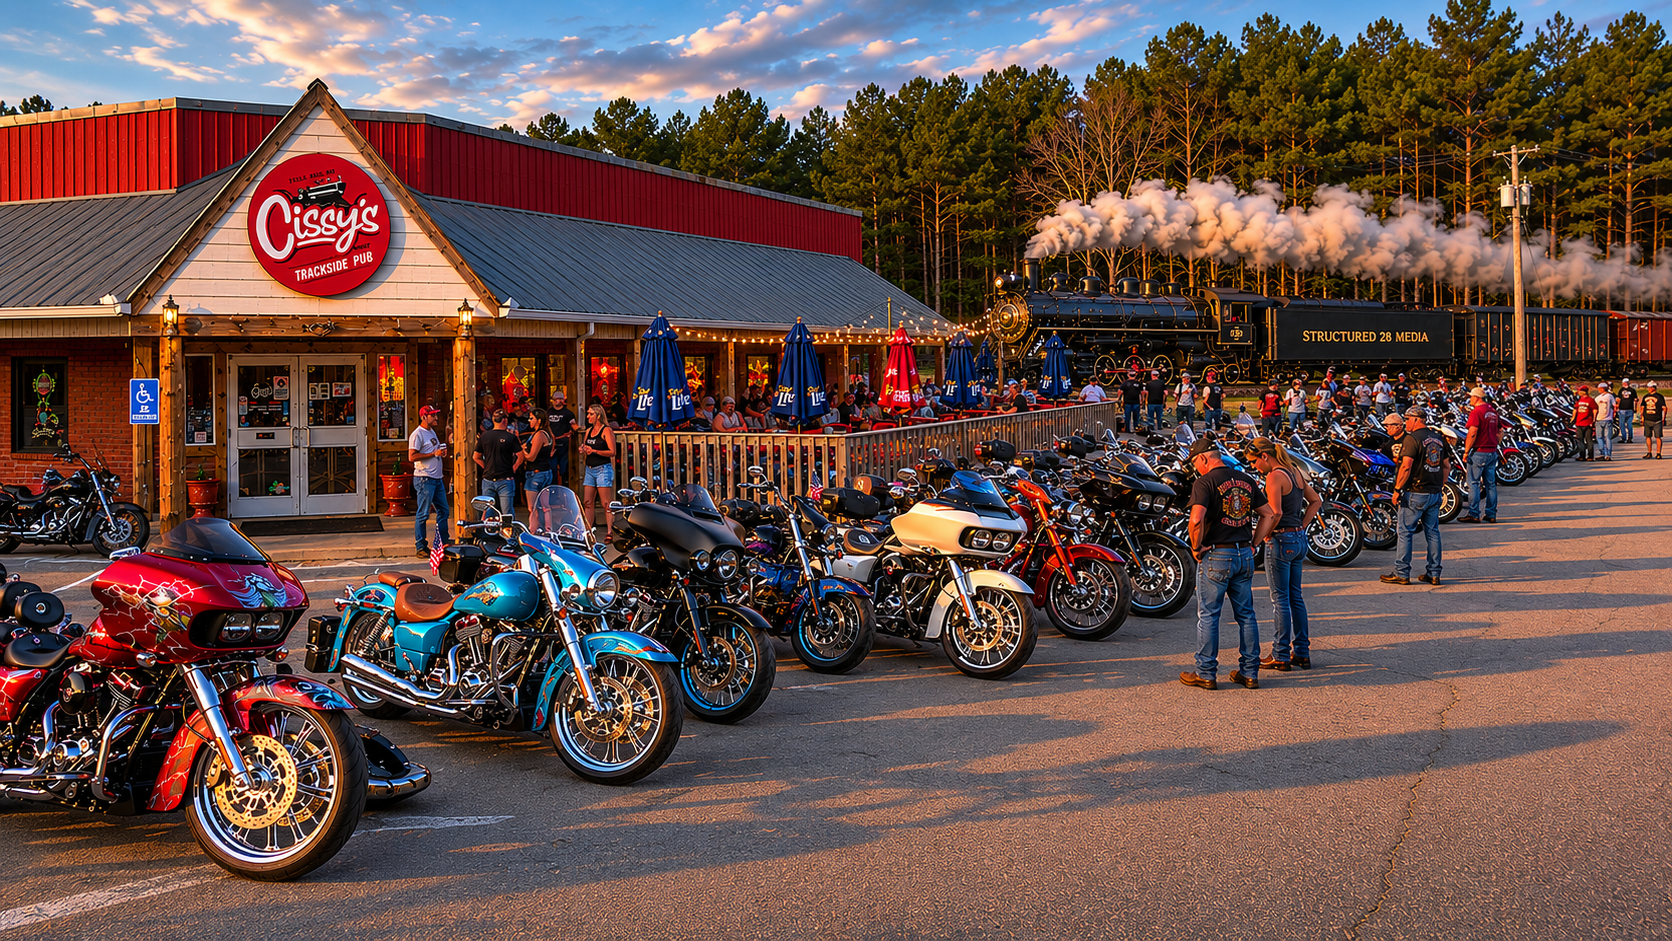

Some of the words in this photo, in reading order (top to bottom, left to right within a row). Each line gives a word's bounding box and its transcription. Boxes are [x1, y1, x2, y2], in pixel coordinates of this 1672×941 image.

[256, 194, 380, 260] Cissy's
[295, 258, 349, 281] TRACKSIDE
[353, 251, 374, 266] PUB
[1302, 330, 1376, 342] STRUCTURED
[1379, 331, 1392, 342] 28
[1395, 331, 1429, 343] MEDIA
